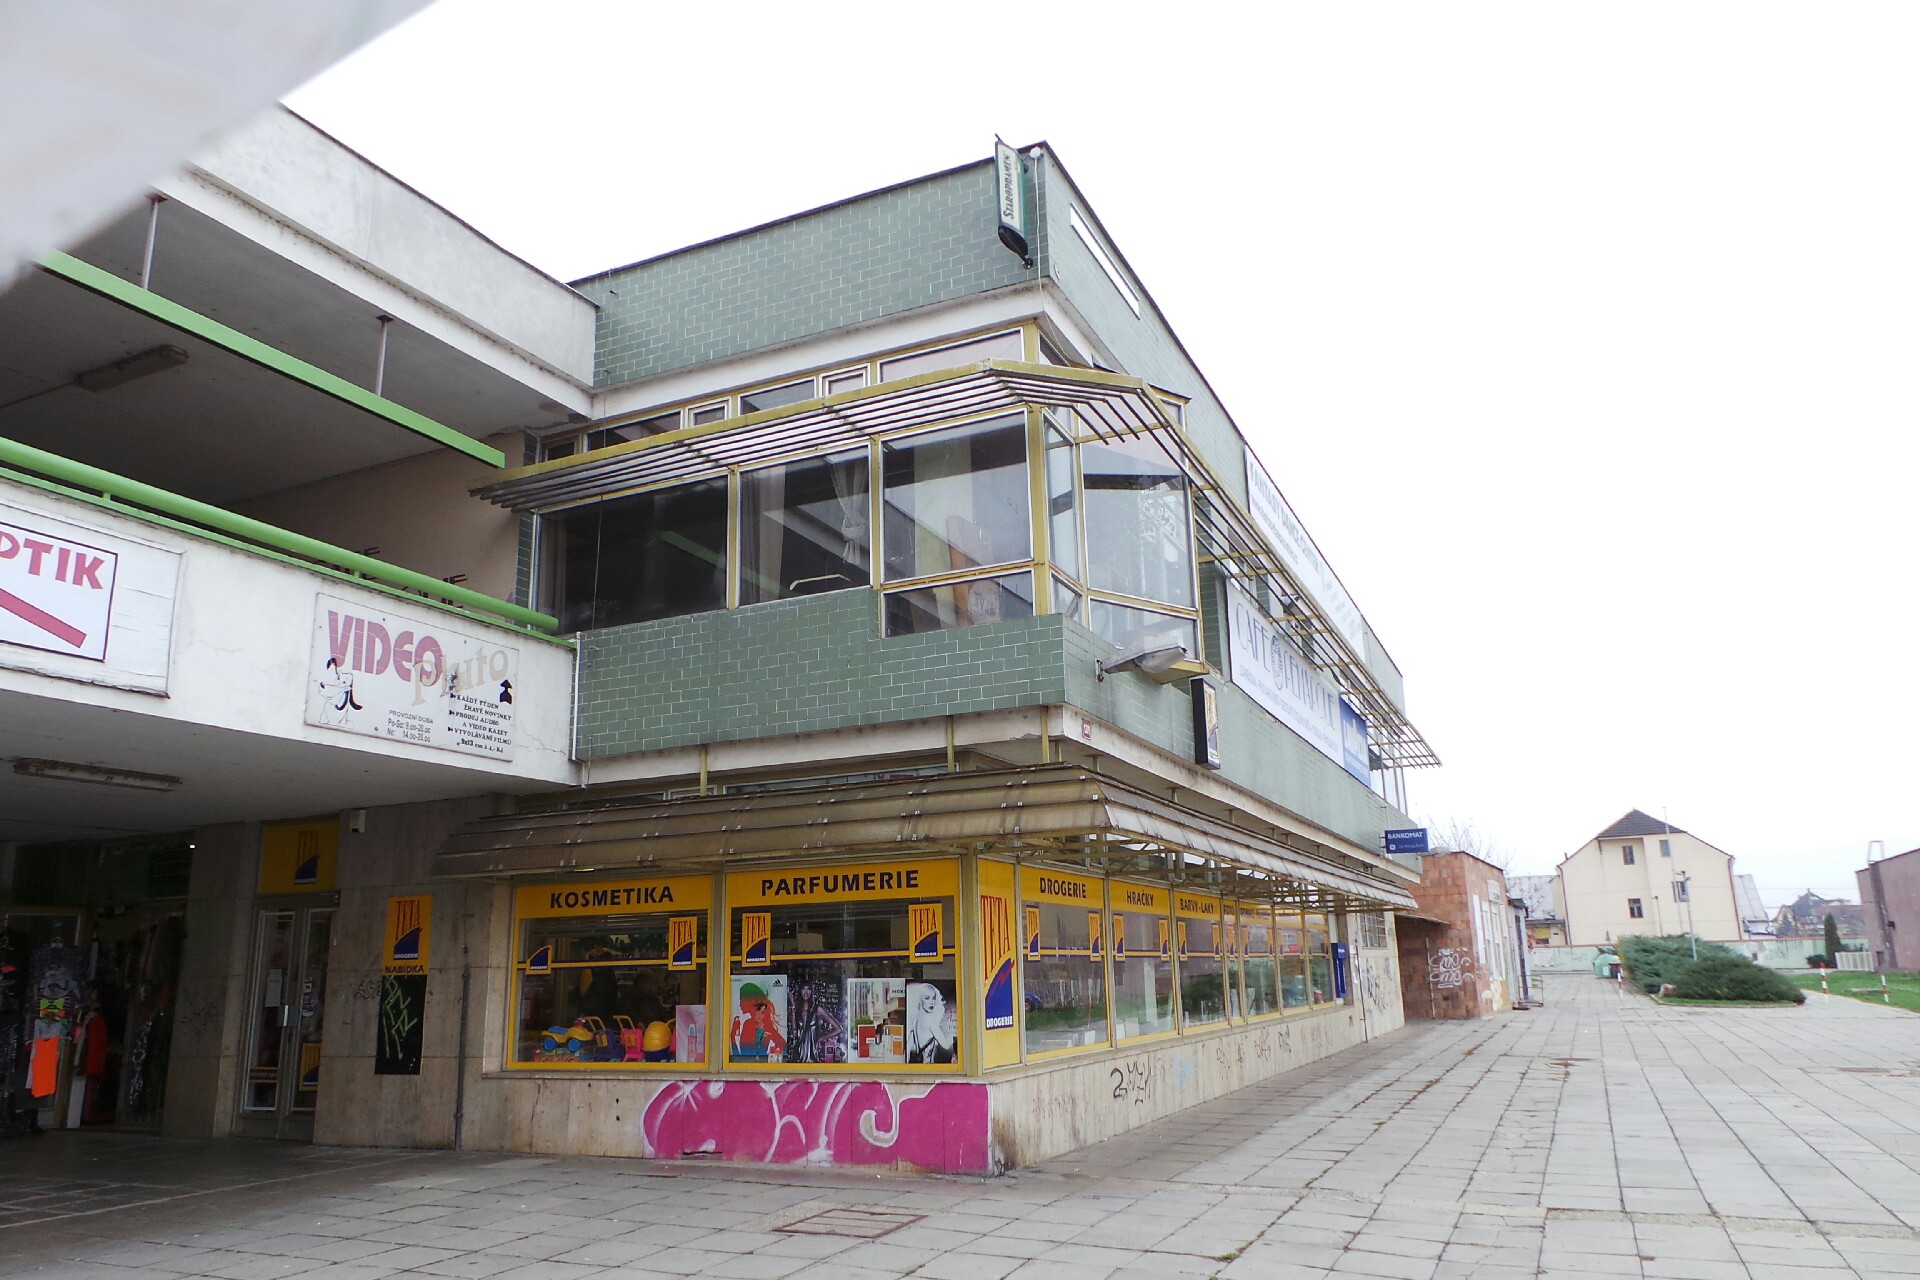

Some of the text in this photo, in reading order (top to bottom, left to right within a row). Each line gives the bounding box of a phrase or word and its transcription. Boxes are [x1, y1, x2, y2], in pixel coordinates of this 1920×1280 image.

[328, 609, 444, 687] VIDEO
[1236, 602, 1271, 673] CAFE
[411, 646, 509, 707] pluto
[463, 704, 512, 721] ŽHAVÉ NOVINKY
[479, 699, 500, 709] TÝDEN
[388, 709, 434, 724] PROVOZNÍ DOBA
[455, 711, 479, 721] PRODEJ
[468, 722, 487, 732] VIDEO
[488, 728, 509, 737] KAZET
[1387, 831, 1424, 840] BANKOMAT
[761, 869, 919, 897] PARFUMERIE
[1039, 877, 1087, 899] DROGERIE
[550, 885, 674, 909] KOSMETIKA
[1126, 889, 1154, 907] HRAČKY
[671, 920, 693, 953] TETA
[744, 915, 766, 948] TETA
[912, 908, 937, 942] TETA
[980, 894, 1011, 981] TETA
[986, 1015, 1013, 1029] DROGERIE
